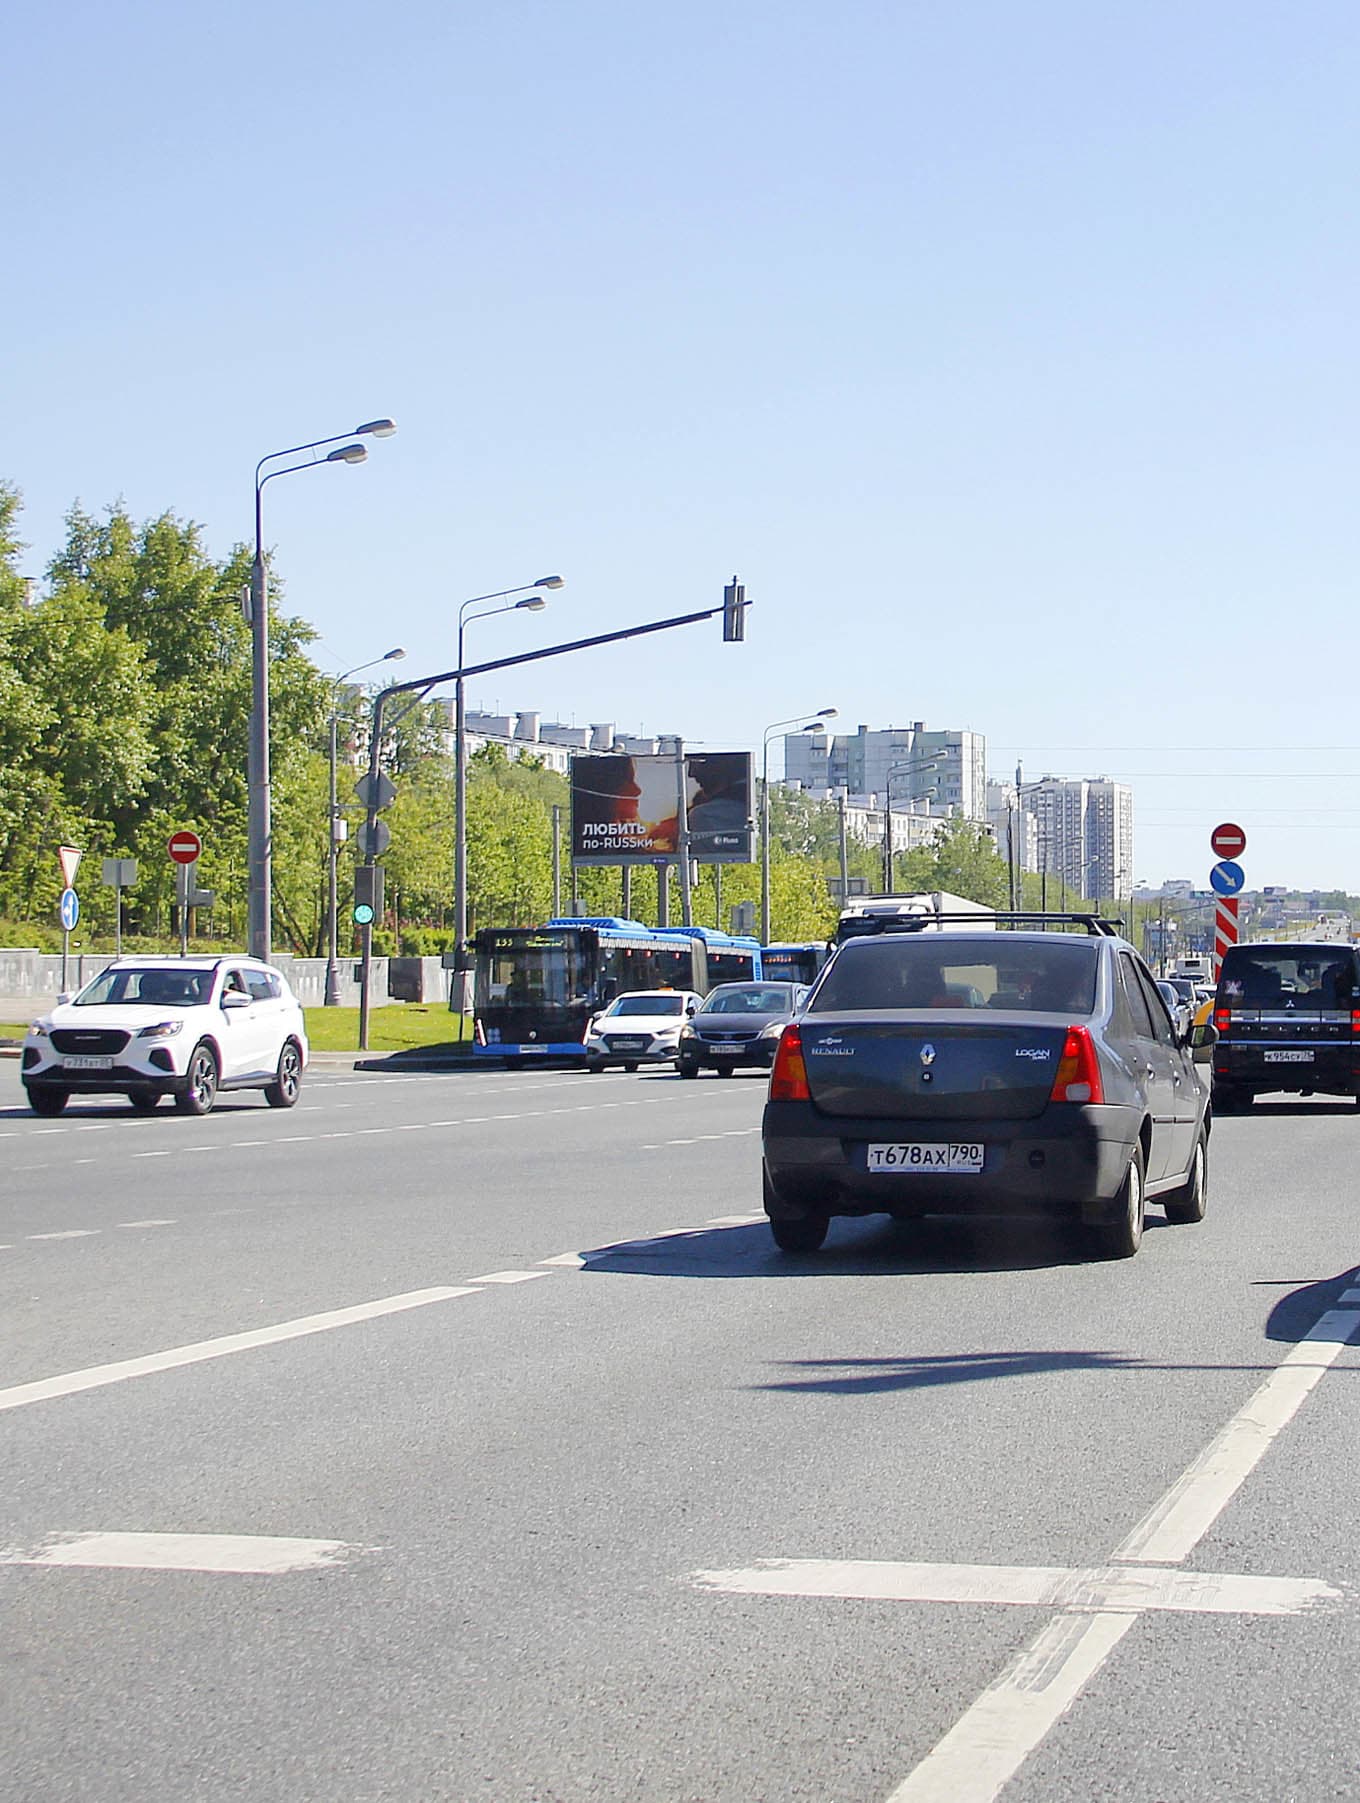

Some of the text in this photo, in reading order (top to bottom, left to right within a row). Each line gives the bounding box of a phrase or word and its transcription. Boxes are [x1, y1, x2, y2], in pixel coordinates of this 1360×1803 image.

[583, 823, 646, 836] ЛЮБИТЬ
[1015, 1049, 1050, 1057] LOGAN
[950, 1145, 979, 1160] 790
